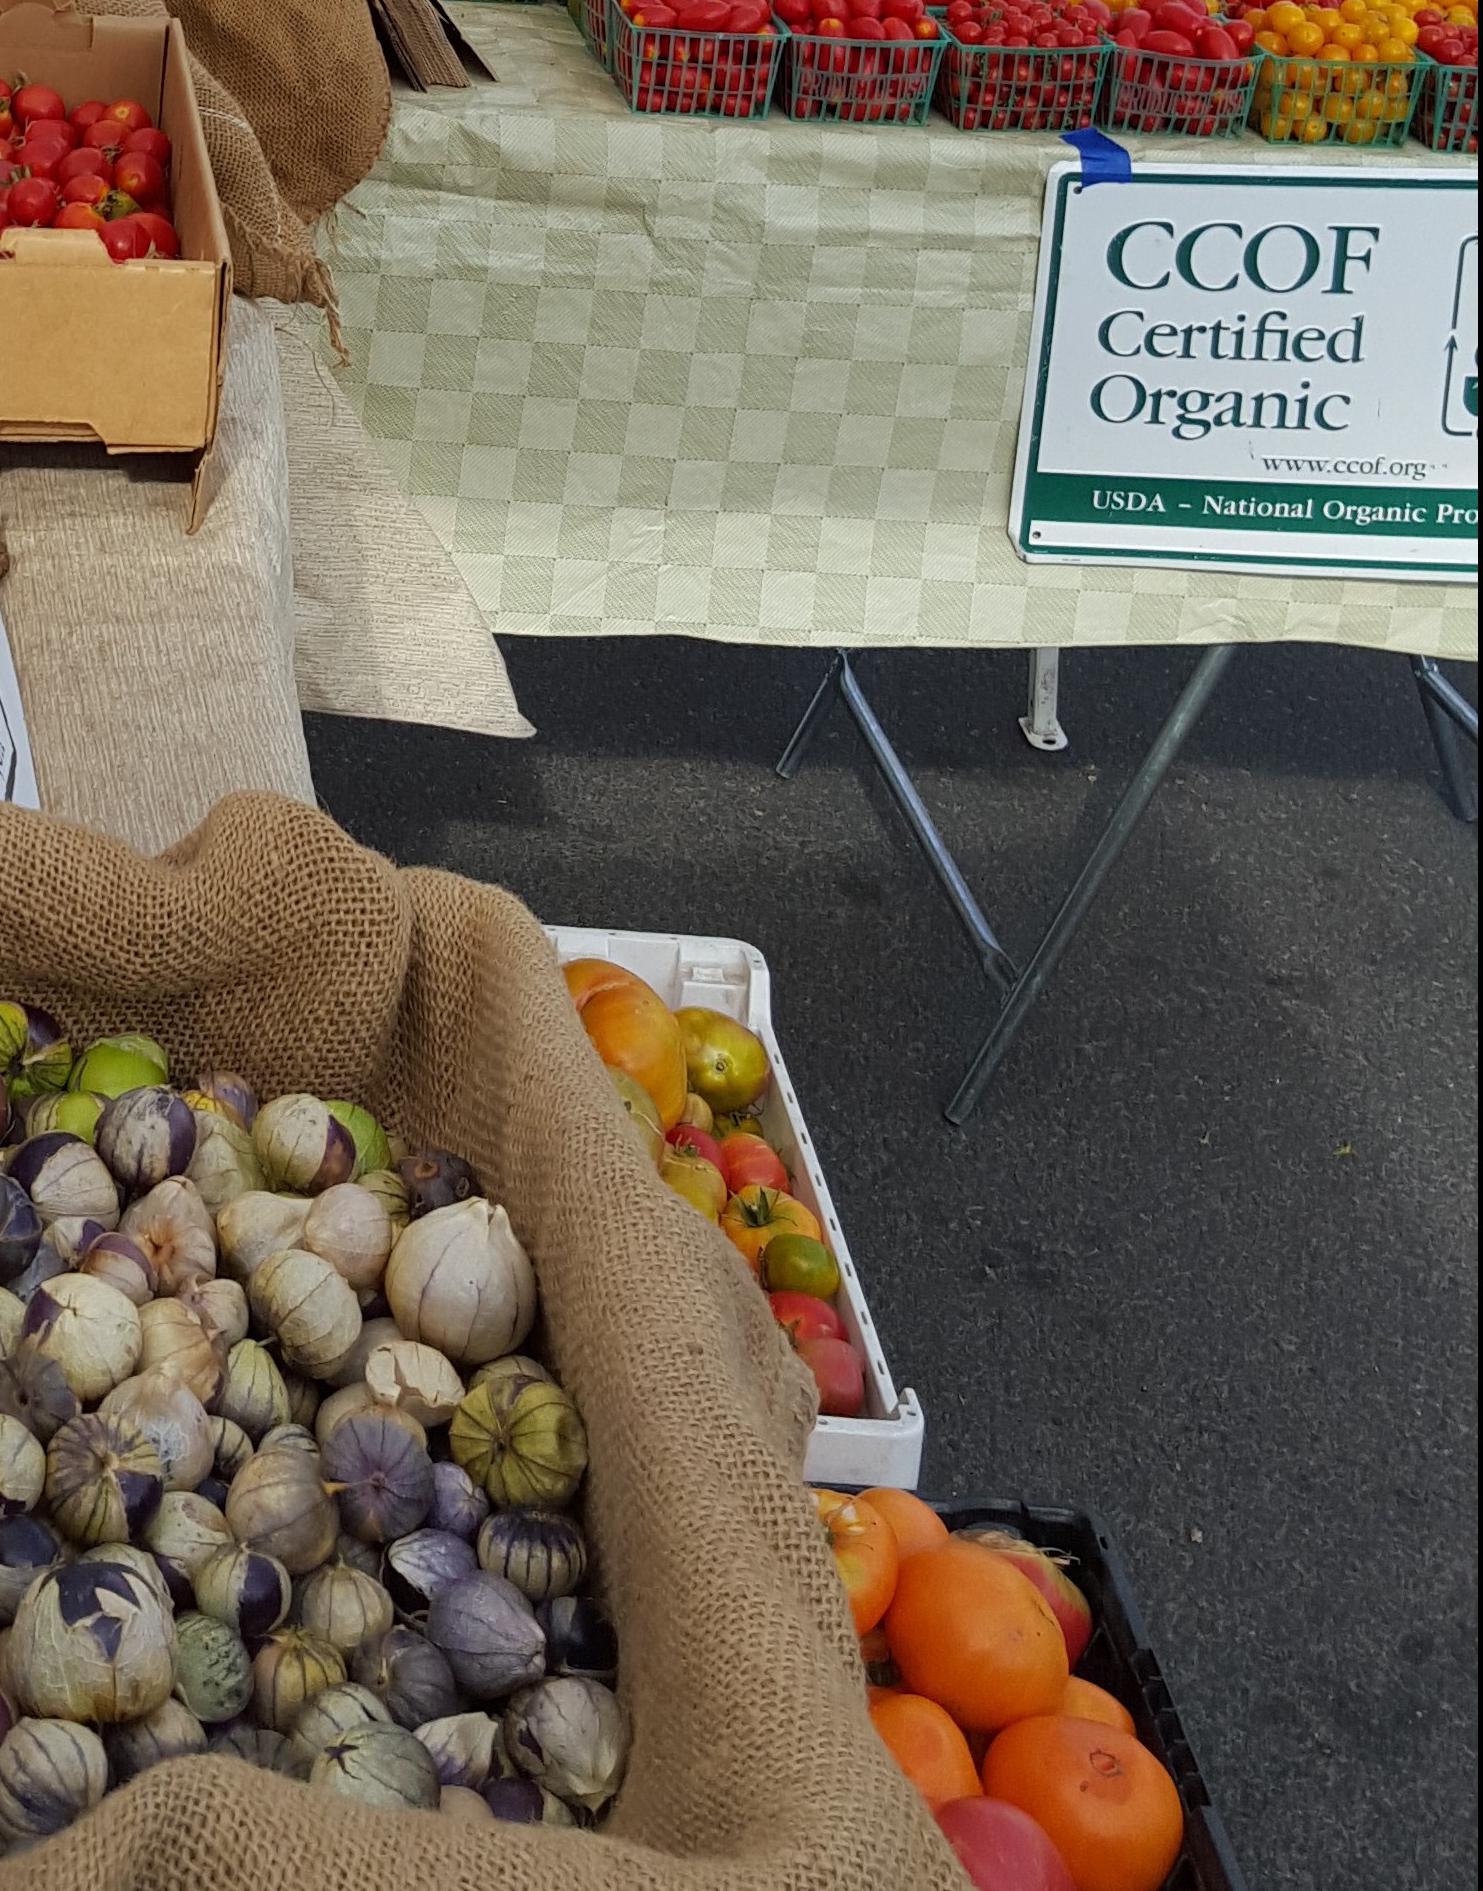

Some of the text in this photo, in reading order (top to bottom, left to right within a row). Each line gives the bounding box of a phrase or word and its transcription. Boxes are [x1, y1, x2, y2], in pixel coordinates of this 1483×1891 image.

[1106, 221, 1380, 294] CCOF
[1098, 310, 1364, 363] Certified
[1090, 374, 1351, 441] Organic
[1262, 456, 1426, 481] www.ccof.org
[1093, 490, 1166, 512] USDA
[1202, 495, 1313, 518] National
[1323, 500, 1427, 526] Organic
